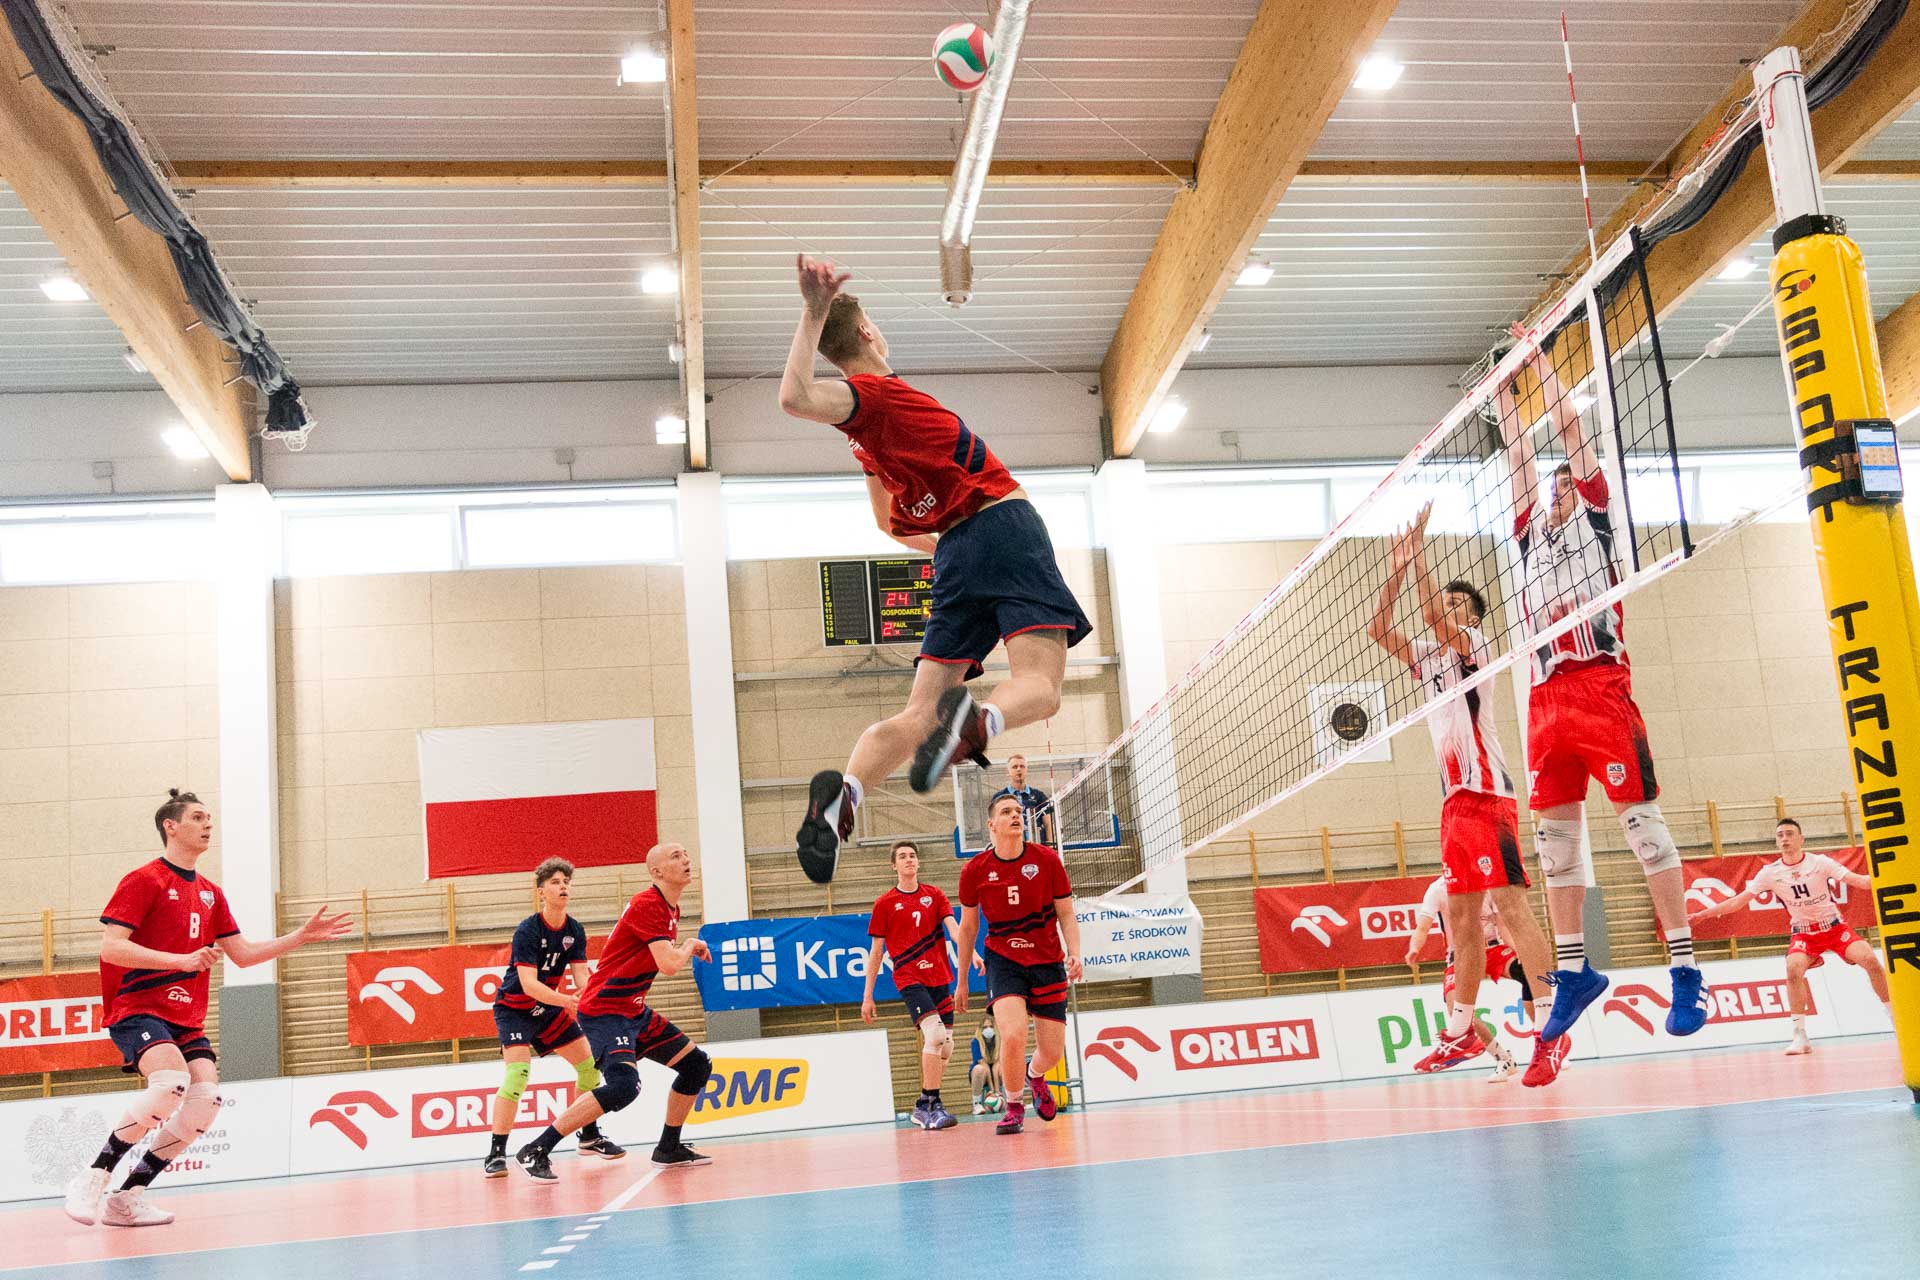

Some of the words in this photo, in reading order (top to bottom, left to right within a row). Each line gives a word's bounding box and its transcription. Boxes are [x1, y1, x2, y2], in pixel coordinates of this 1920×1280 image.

[1782, 305, 1842, 522] SPO
[886, 592, 909, 606] 24
[881, 608, 922, 616] GOSPODARZE
[1831, 600, 1920, 974] TRANSFER
[1007, 885, 1020, 905] 5
[1791, 883, 1811, 899] 14
[911, 911, 922, 927] 7
[1101, 907, 1184, 921] FINAOWANY
[1366, 909, 1438, 935] ORL
[189, 912, 200, 939] 8
[1111, 931, 1125, 942] ZE
[1128, 925, 1187, 940] ŚRODKÓW
[1084, 953, 1127, 966] MIASTA
[1130, 948, 1190, 961] KRAKOWA
[0, 1003, 103, 1040] RLE
[141, 1031, 151, 1041] 8
[509, 1032, 523, 1041] 14
[615, 1036, 630, 1046] 12
[1179, 1024, 1310, 1064] ORLEN
[694, 1066, 801, 1112] RMF
[419, 1088, 568, 1131] OREN
